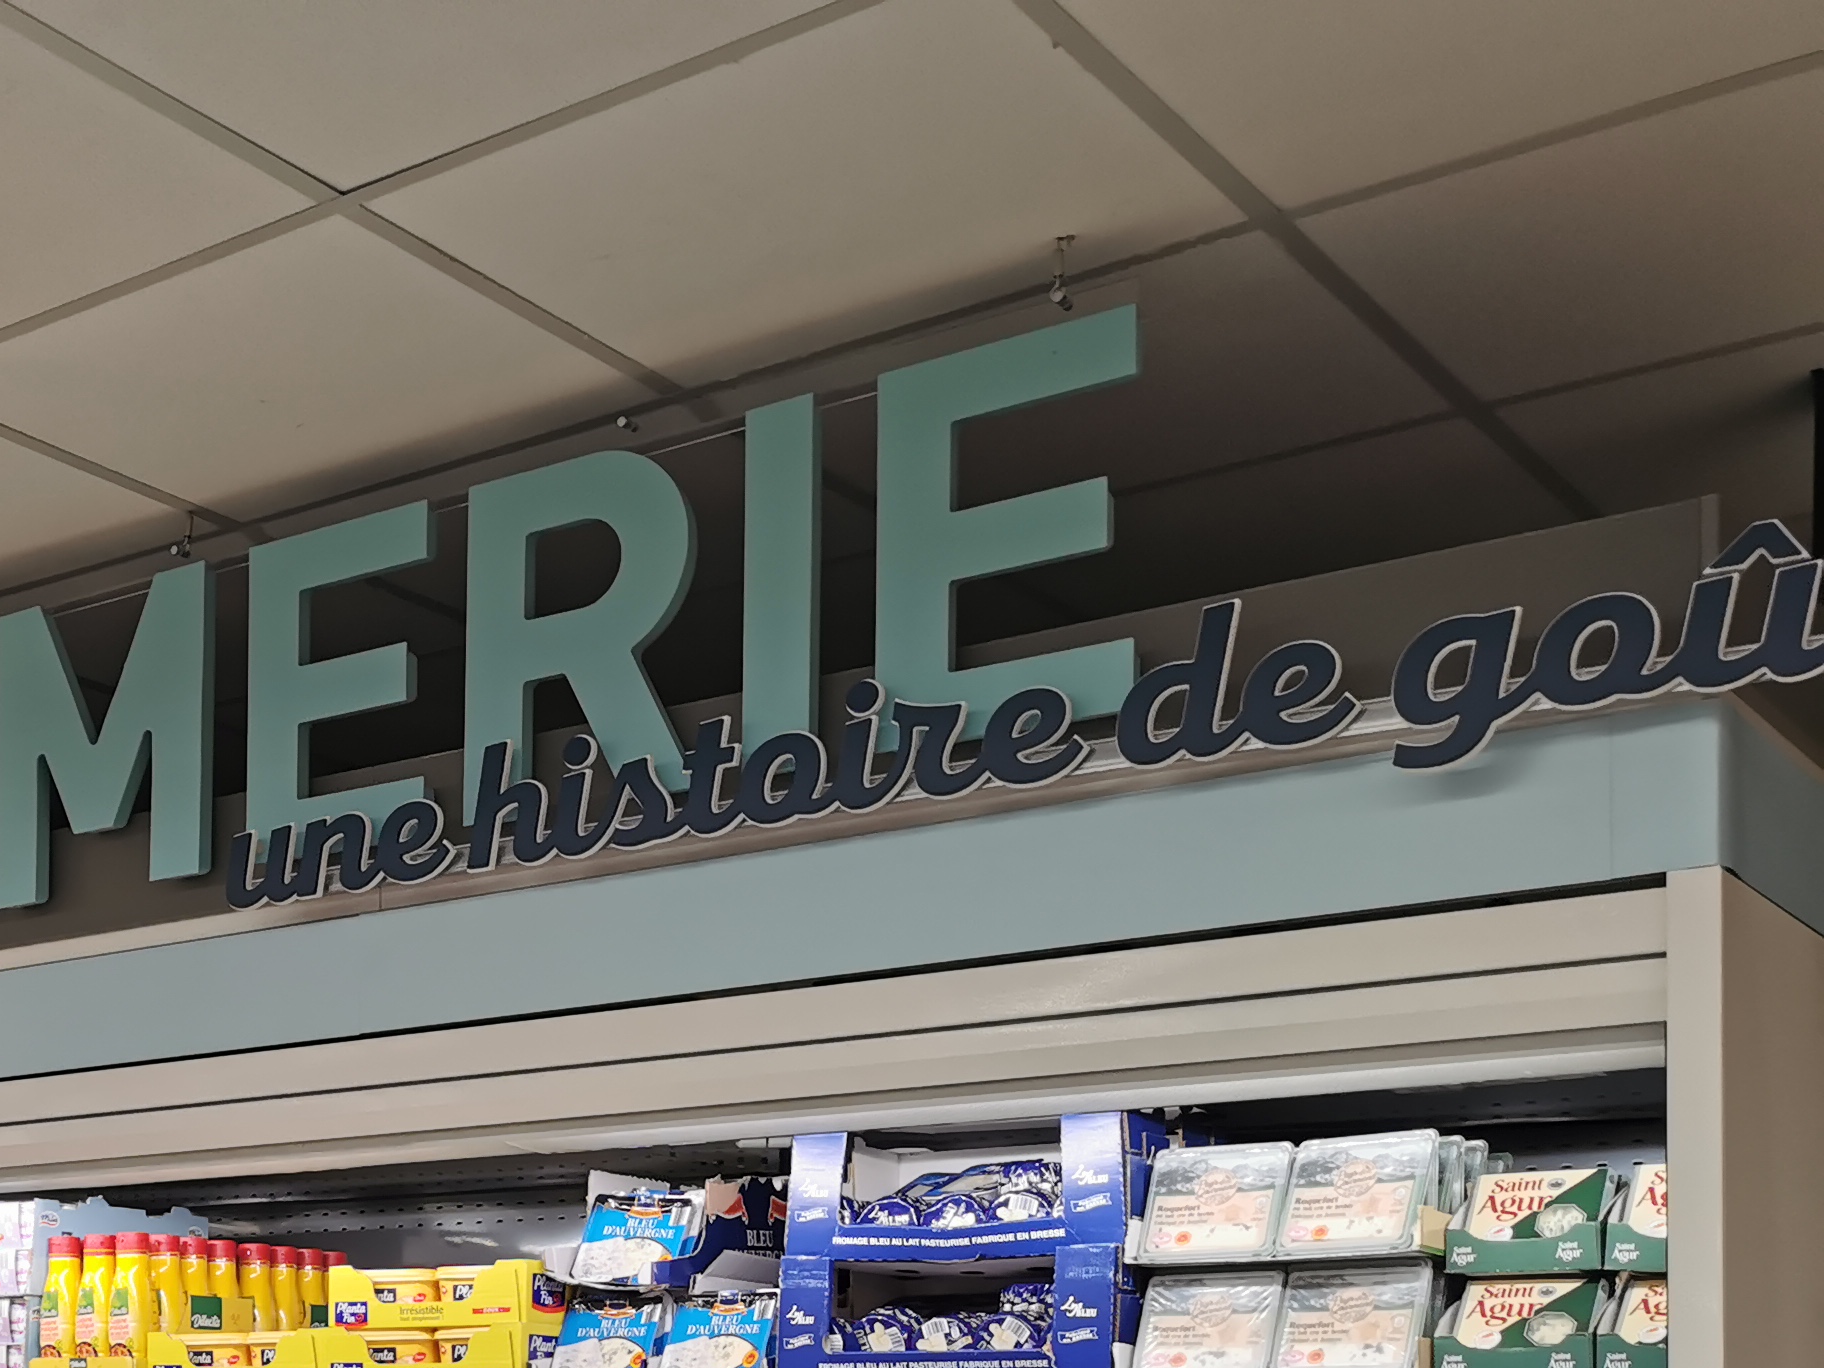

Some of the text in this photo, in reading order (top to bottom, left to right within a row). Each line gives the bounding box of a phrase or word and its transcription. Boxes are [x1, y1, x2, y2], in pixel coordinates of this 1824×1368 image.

[223, 800, 457, 912] une
[466, 678, 1090, 872] histoire
[1115, 596, 1358, 768] de
[1492, 1177, 1545, 1196] Saint
[1477, 1192, 1554, 1221] Agur
[602, 1224, 677, 1240] D'AUVERGNE
[625, 1217, 658, 1230] BLEU
[745, 1229, 774, 1249] BLEU
[832, 1228, 1066, 1247] FROMAGE BLEU AU LAIT PASTEURISE FABRIQUE EN BRESSE
[1480, 1283, 1535, 1303] Saint
[335, 1301, 367, 1314] Planta
[1465, 1299, 1543, 1327] Agur
[342, 1312, 357, 1324] Fin
[709, 1313, 743, 1327] BLEU
[686, 1322, 761, 1336] D'AUVERGNE
[908, 1361, 958, 1368] PASTEURISE
[959, 1360, 1001, 1368] FABRIQUE
[1001, 1360, 1014, 1368] EN
[1014, 1359, 1049, 1368] BRESSE
